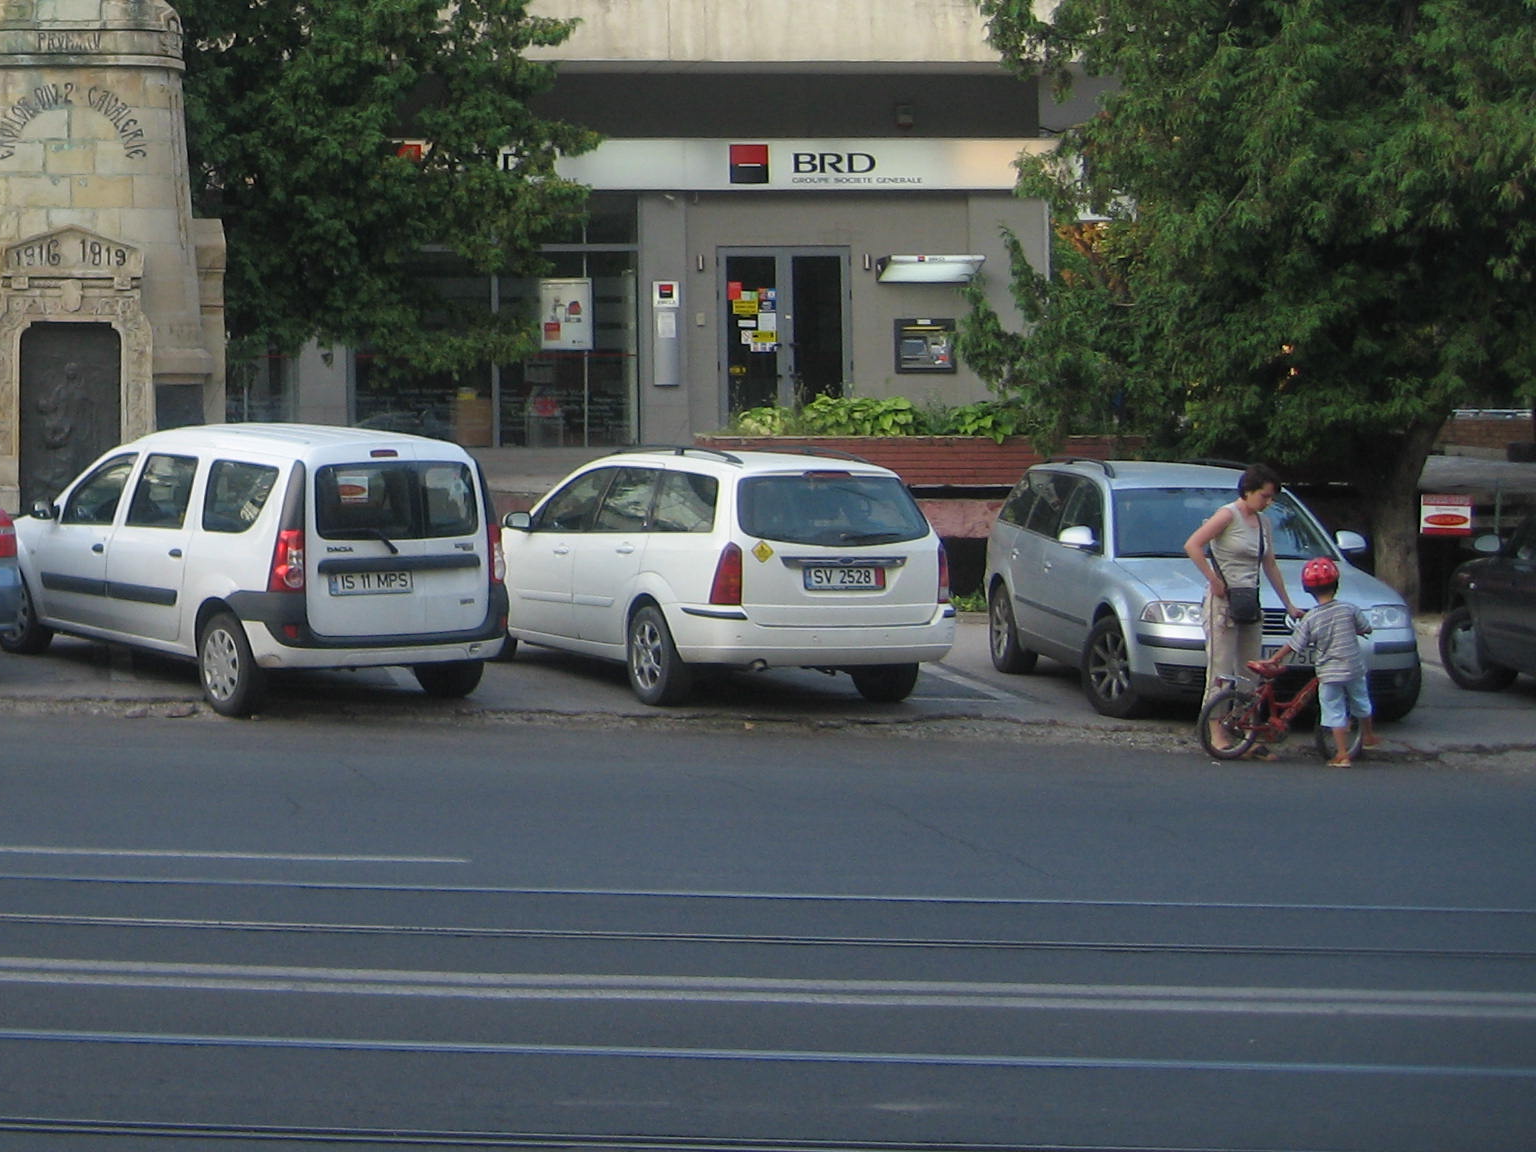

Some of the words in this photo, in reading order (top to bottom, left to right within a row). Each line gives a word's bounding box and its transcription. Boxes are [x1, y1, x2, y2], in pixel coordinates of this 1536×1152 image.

[792, 152, 876, 174] BRD
[15, 239, 61, 266] 1916
[341, 575, 356, 590] IS
[360, 574, 372, 589] 11
[377, 572, 409, 589] MPS
[814, 569, 834, 585] SV
[839, 569, 872, 585] 2528
